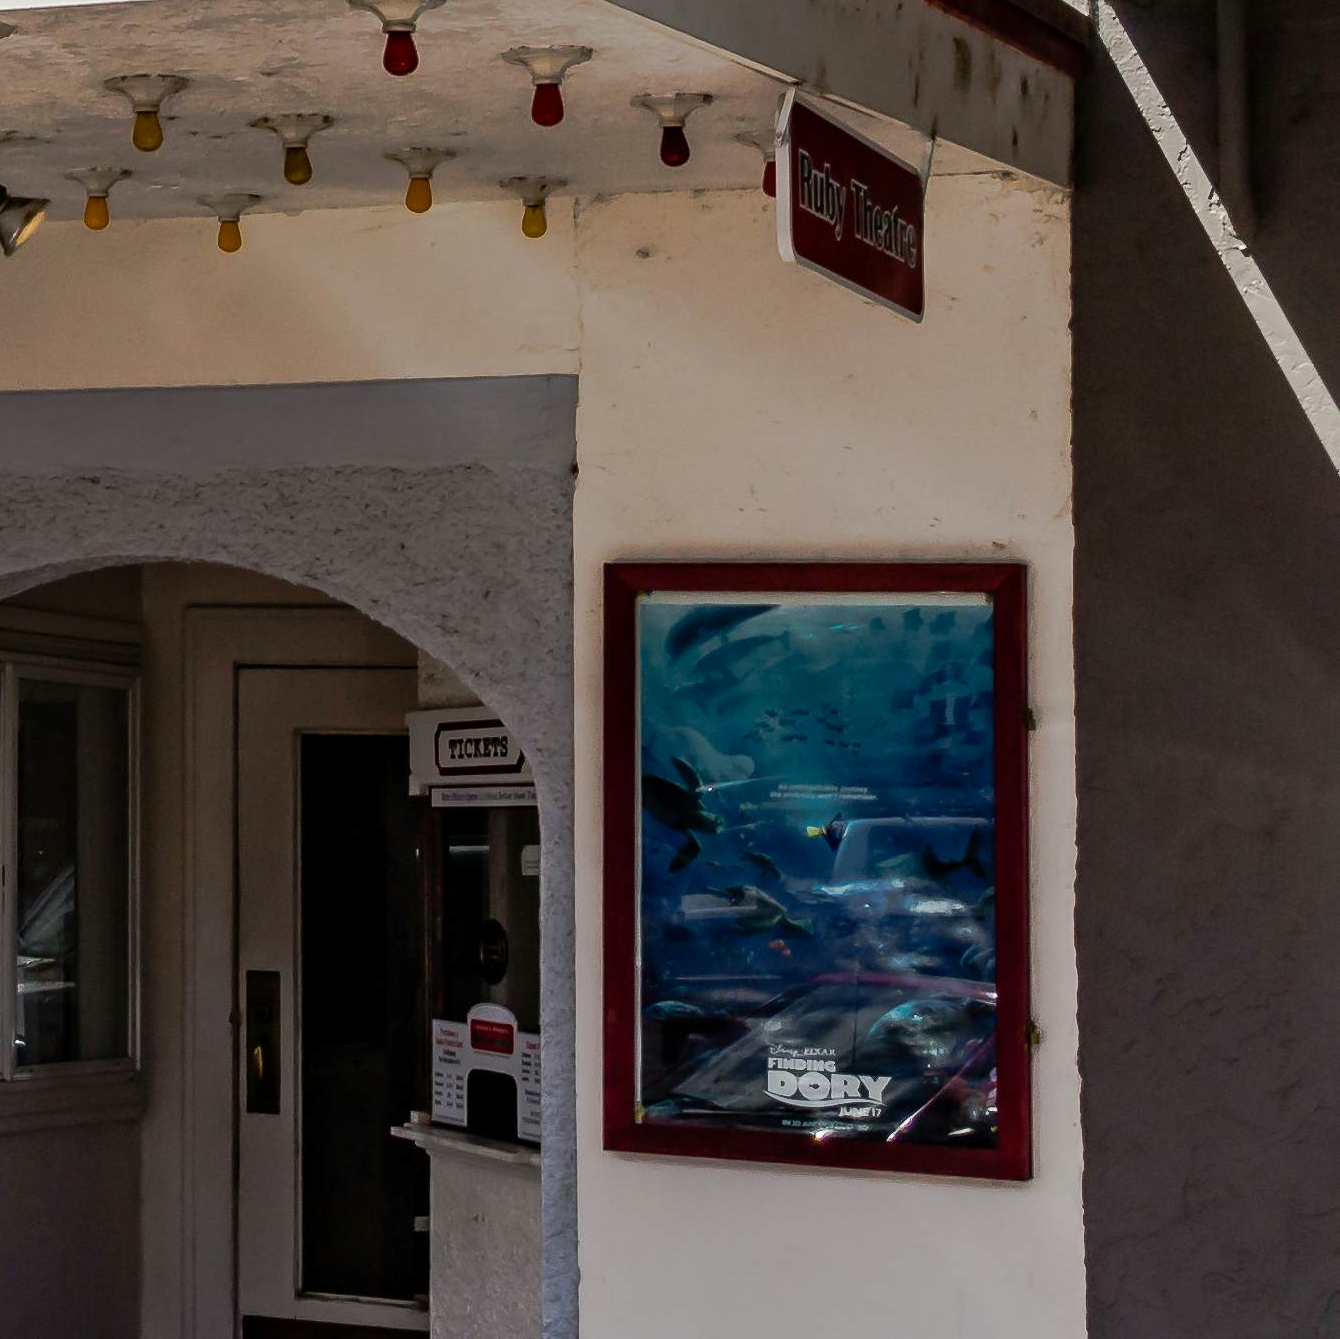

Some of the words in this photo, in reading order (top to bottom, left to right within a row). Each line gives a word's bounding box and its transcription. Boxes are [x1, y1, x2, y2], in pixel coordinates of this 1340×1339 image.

[799, 148, 847, 242] Ruby
[850, 177, 917, 268] Theatre
[448, 736, 509, 760] TICKETS
[767, 1057, 837, 1073] FINDING
[767, 1070, 892, 1103] DORY
